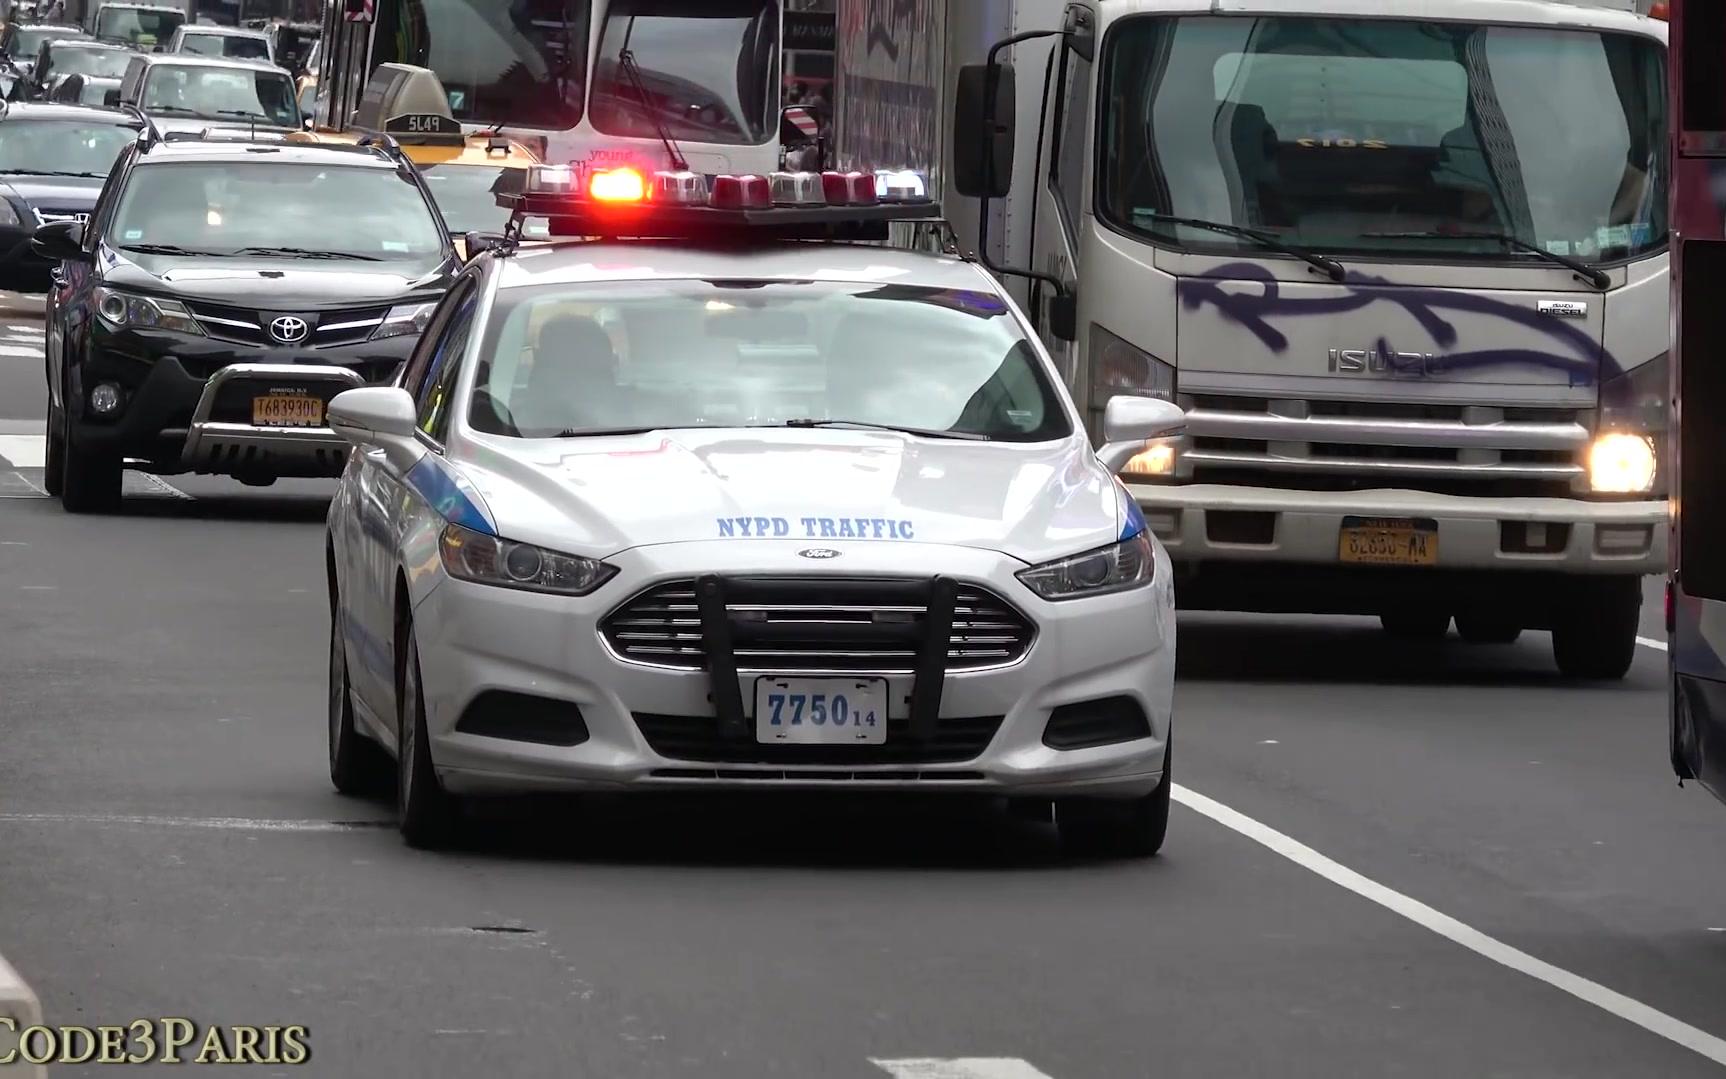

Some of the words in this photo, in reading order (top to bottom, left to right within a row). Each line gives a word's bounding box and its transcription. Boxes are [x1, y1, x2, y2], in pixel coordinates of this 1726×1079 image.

[257, 399, 318, 418] T683930C
[717, 517, 789, 537] NYPD
[801, 517, 915, 539] TRAFFIC
[804, 548, 836, 559] Ford
[768, 694, 848, 726] 7750
[853, 711, 876, 727] 14
